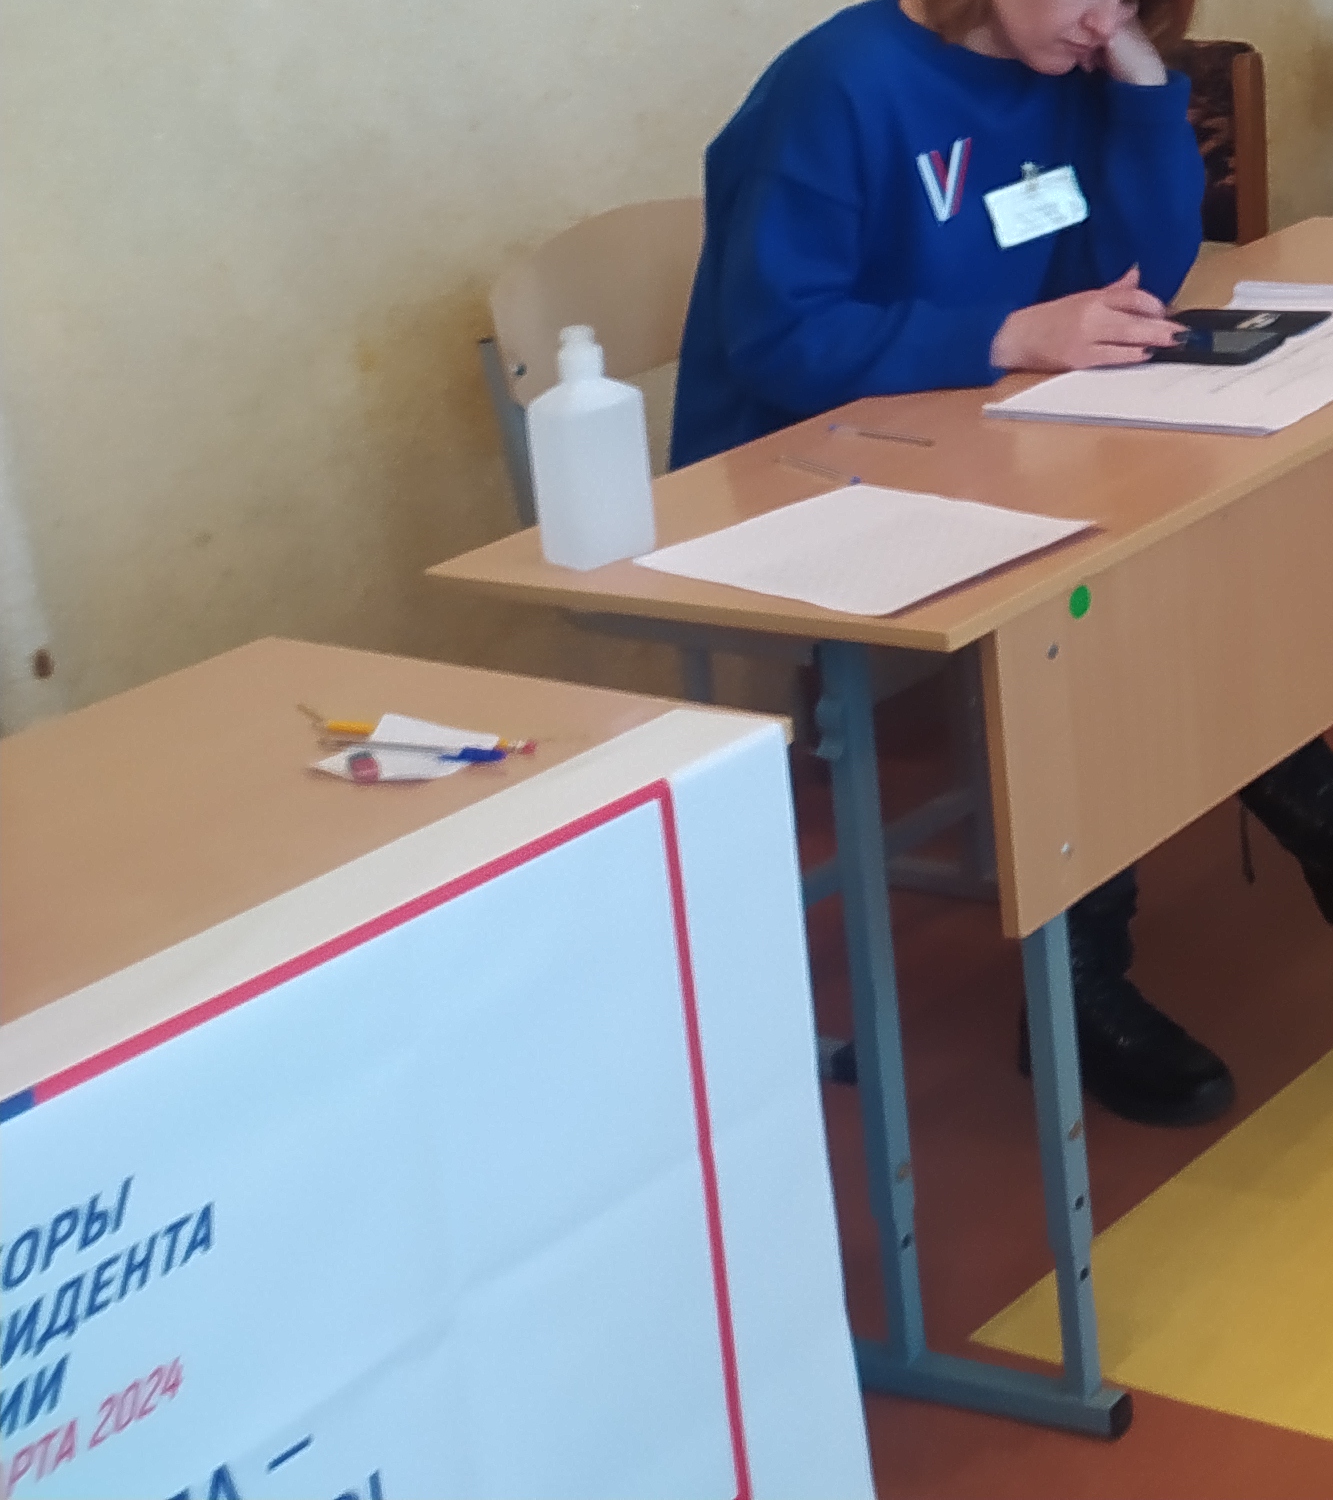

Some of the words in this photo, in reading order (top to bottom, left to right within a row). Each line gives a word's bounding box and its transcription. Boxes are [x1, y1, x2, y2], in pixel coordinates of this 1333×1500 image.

[0, 1176, 134, 1292] ОРЫ
[0, 1202, 214, 1368] ИДЕНТА
[87, 1355, 184, 1448] 2024
